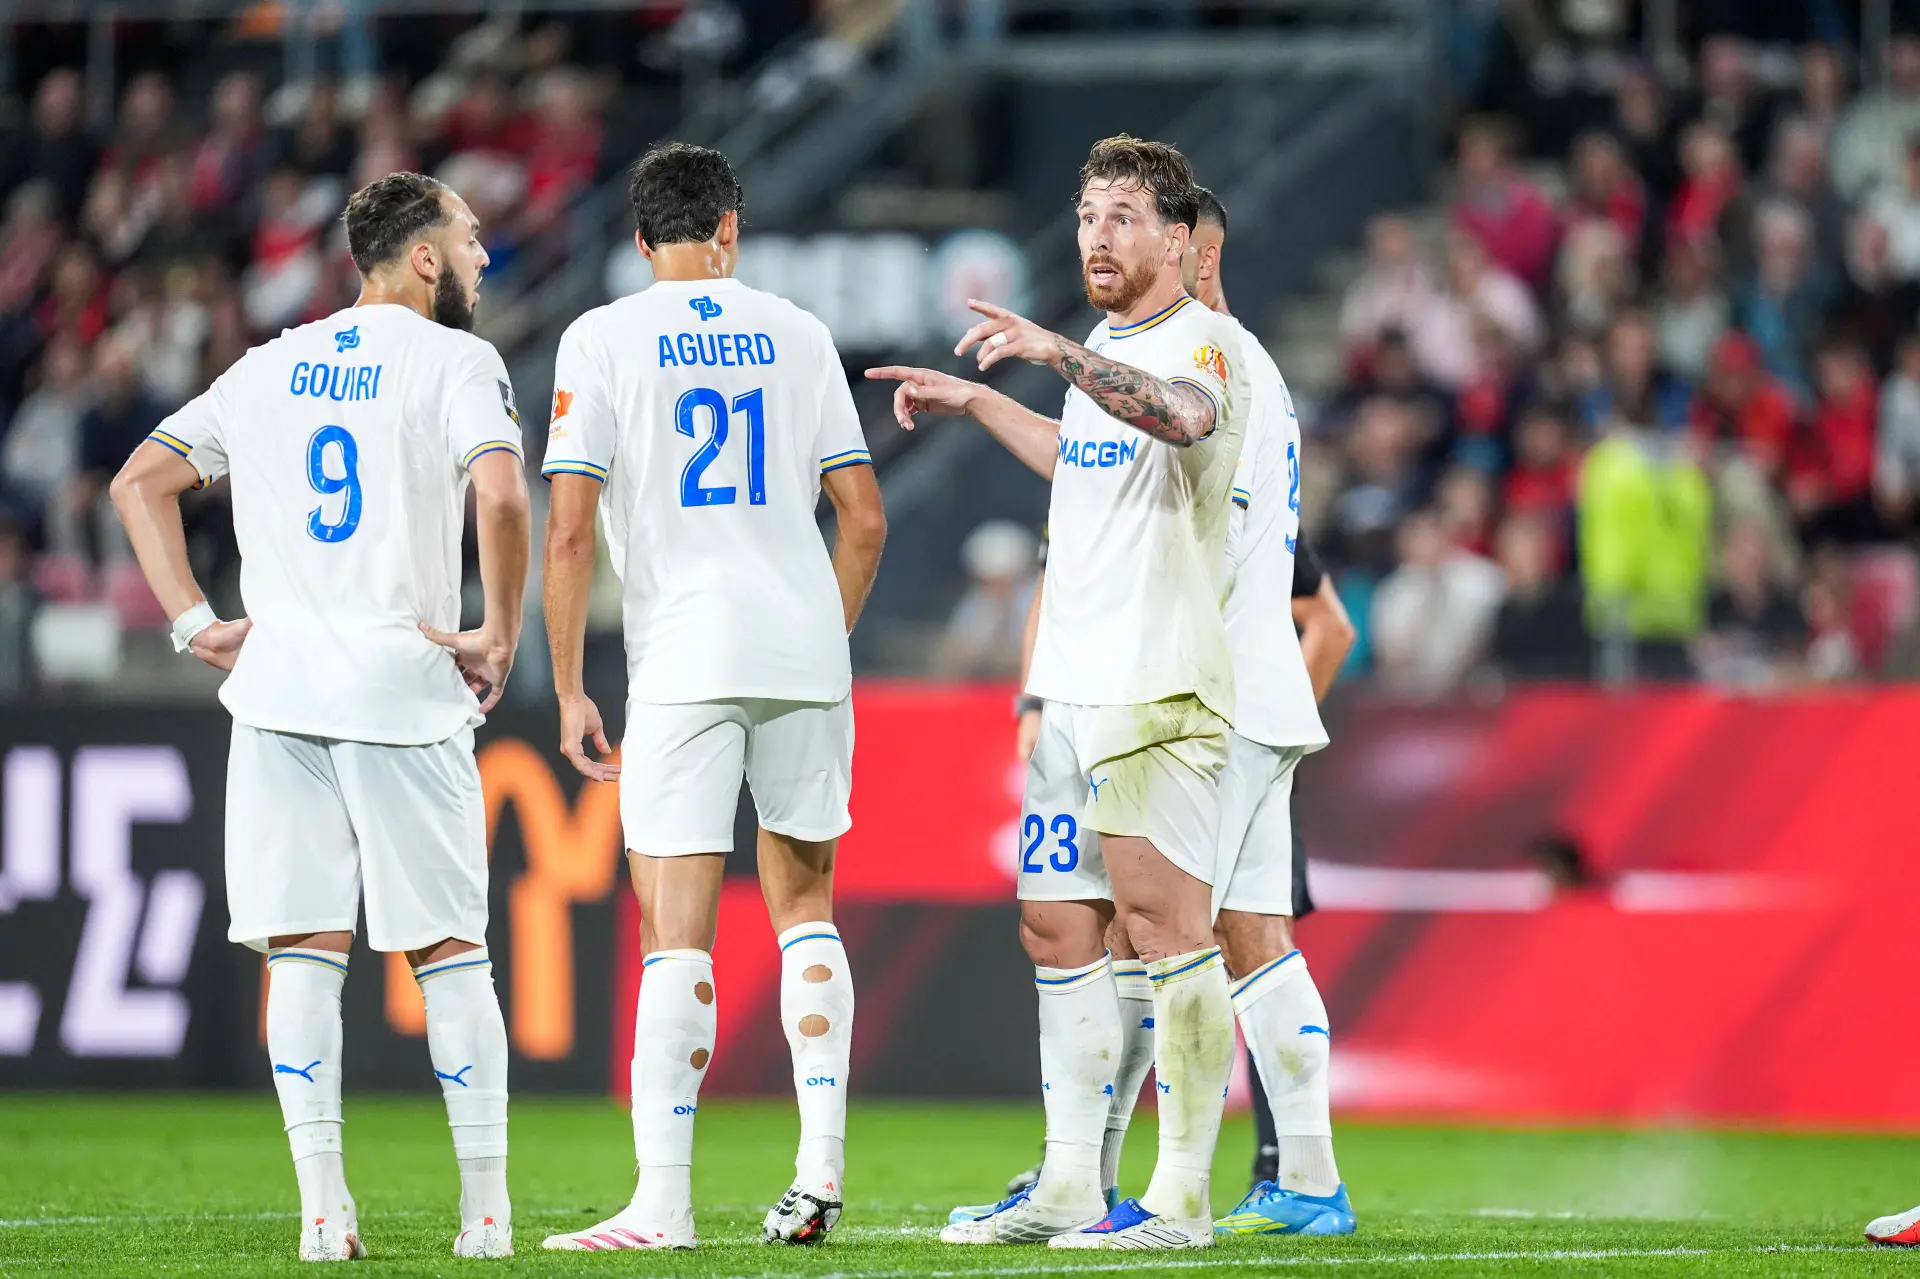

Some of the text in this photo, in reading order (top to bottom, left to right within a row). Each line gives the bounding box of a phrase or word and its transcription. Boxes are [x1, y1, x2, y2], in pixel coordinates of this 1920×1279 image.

[658, 332, 776, 368] AGUERD
[290, 361, 382, 402] GOUIRI
[675, 387, 767, 507] 21
[1057, 434, 1139, 468] MACGM
[306, 424, 363, 543] 9
[1023, 813, 1079, 874] 23
[806, 1076, 836, 1087] OM
[673, 1104, 697, 1116] OM
